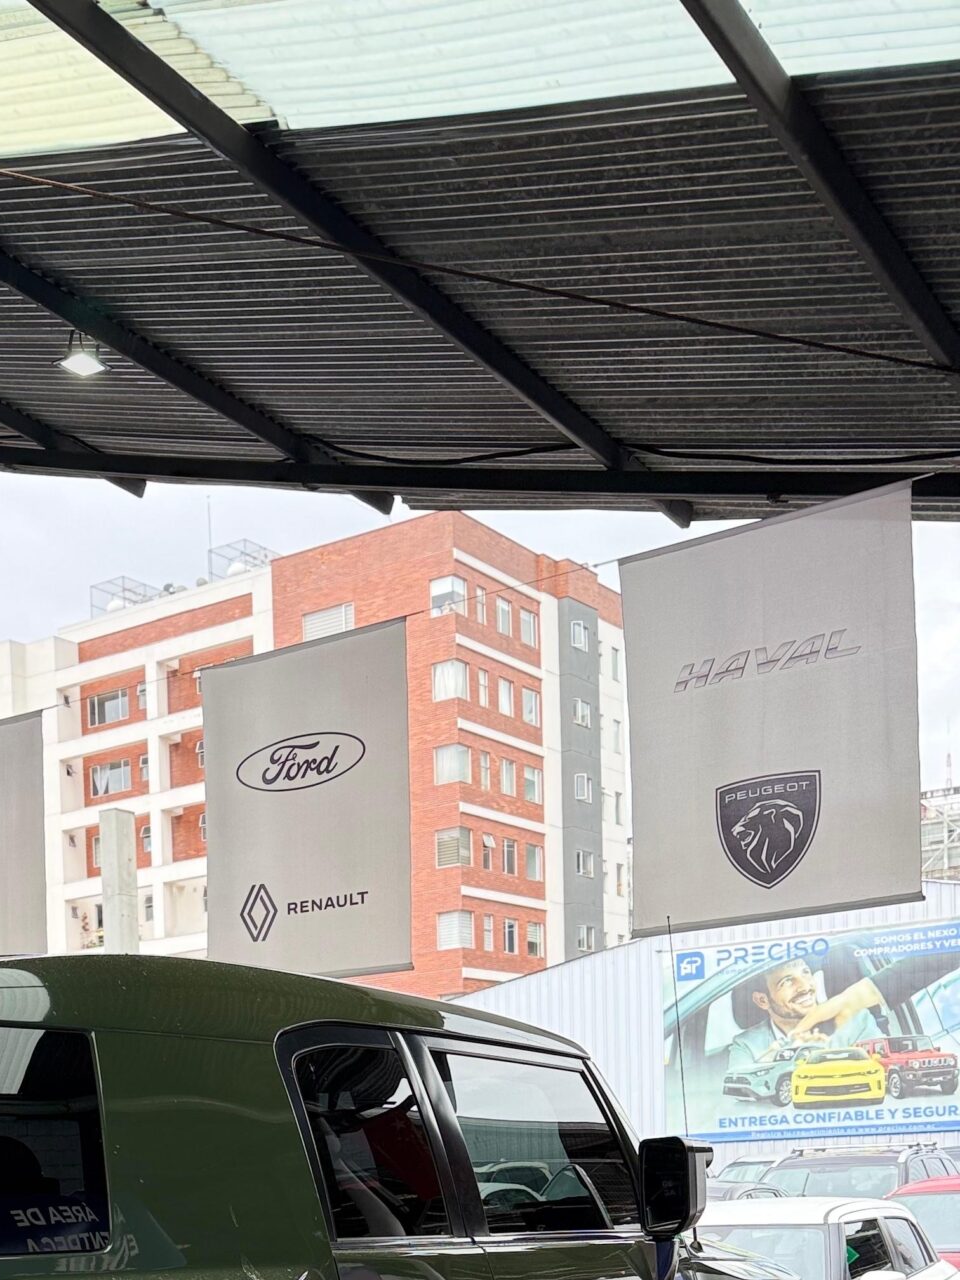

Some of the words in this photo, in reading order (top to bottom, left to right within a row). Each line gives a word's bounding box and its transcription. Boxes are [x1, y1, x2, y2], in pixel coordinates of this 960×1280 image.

[673, 628, 863, 693] HAVAL
[261, 740, 339, 786] Ford
[724, 780, 810, 804] PEUGEOT
[287, 891, 369, 916] RENAULT
[854, 941, 933, 957] COMPRADORES
[935, 941, 942, 949] Y
[943, 938, 960, 948] VE
[874, 933, 912, 945] SOMOS
[913, 931, 926, 940] EL
[928, 928, 957, 938] NEXO
[716, 937, 829, 967] PRECISO
[718, 1114, 790, 1129] ENTREGA
[793, 1109, 884, 1125] CONFIABLE
[887, 1108, 899, 1119] Y
[902, 1104, 960, 1119] SEGUR
